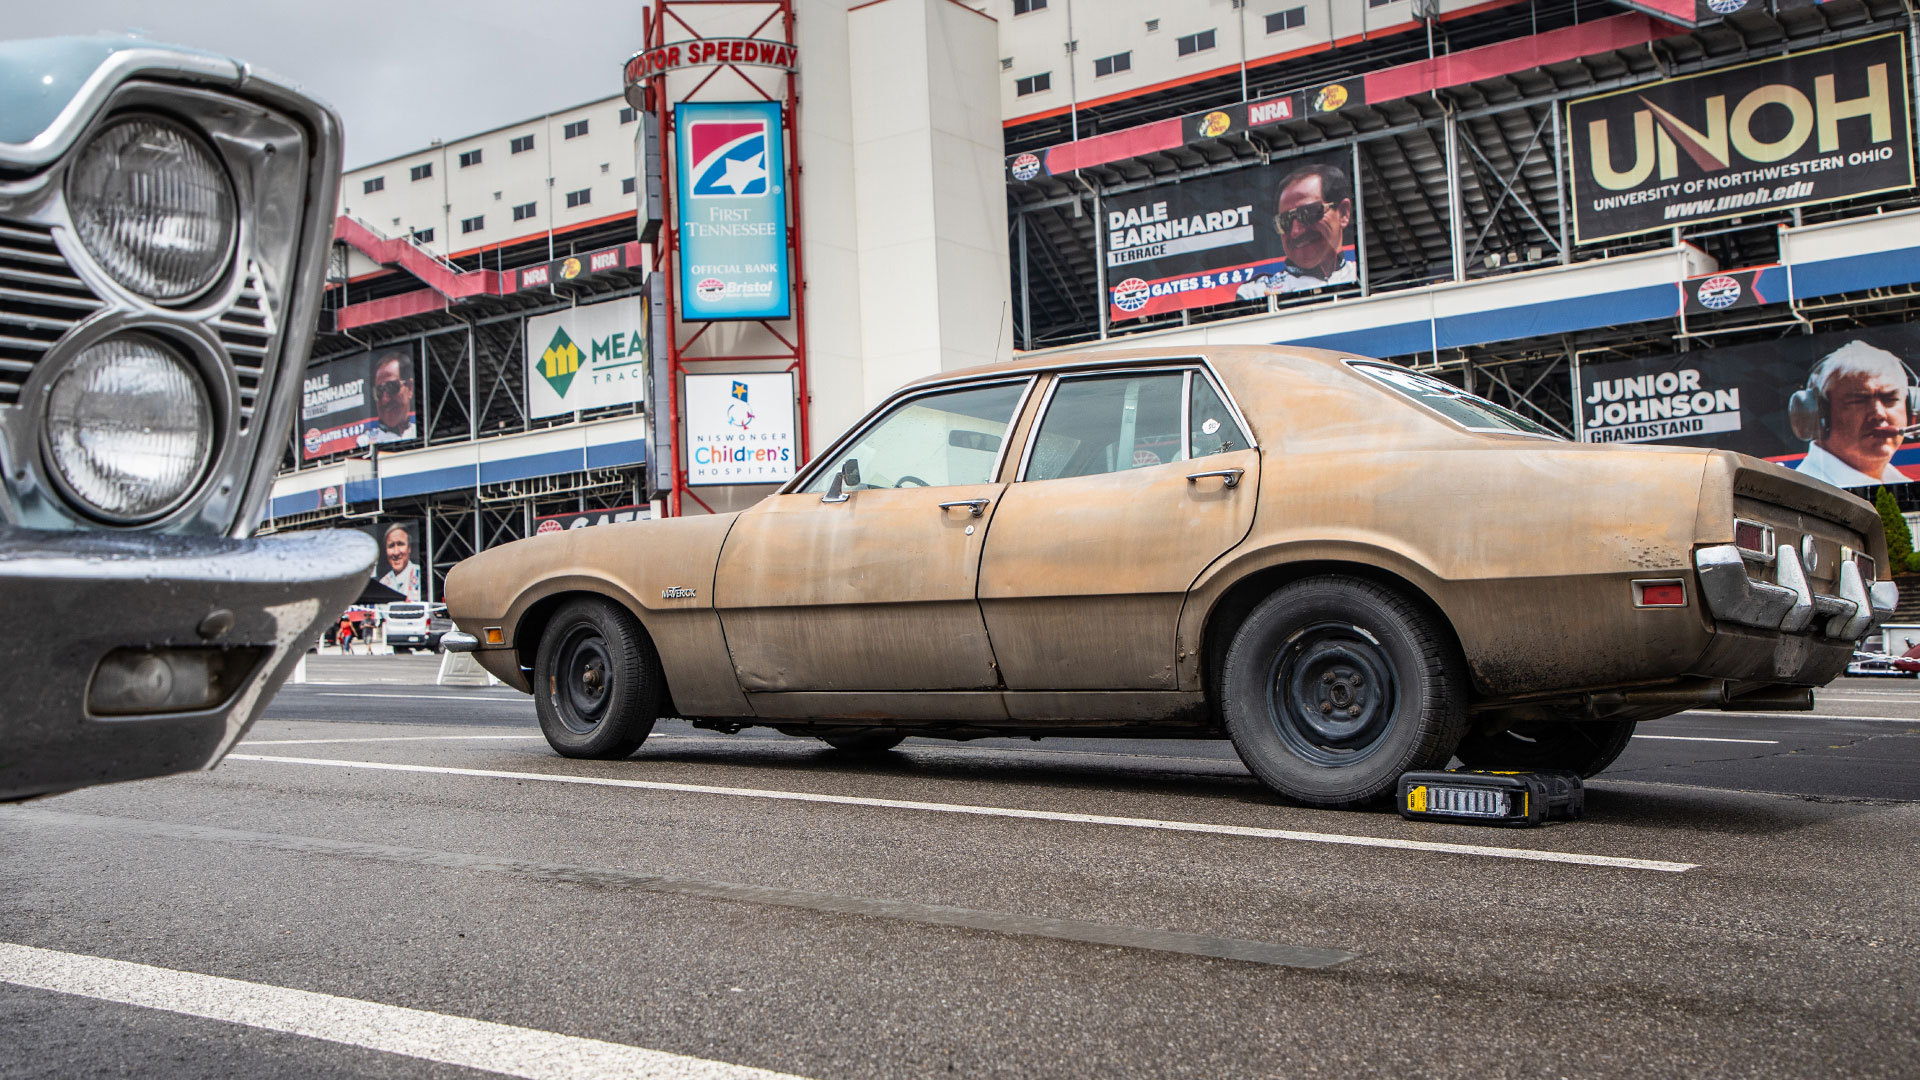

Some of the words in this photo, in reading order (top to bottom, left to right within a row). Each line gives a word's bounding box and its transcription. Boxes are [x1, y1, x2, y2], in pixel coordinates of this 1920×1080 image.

[628, 46, 680, 82] MOTOR
[688, 41, 798, 68] SPEEDWAY
[1251, 101, 1289, 123] NRA
[1589, 63, 1892, 190] UNOH
[1593, 183, 1681, 211] UNIVERSITY
[1684, 178, 1705, 194] OF
[1707, 155, 1844, 190] NORTHWESTERN
[1848, 146, 1893, 167] OHIO
[1664, 180, 1814, 220] www.unoh.edu
[709, 206, 752, 221] FIRST
[1109, 201, 1168, 231] DALE
[685, 222, 776, 237] TENNESSEE
[1110, 205, 1253, 251] EARNHARDT
[592, 252, 618, 270] NRA
[1113, 243, 1167, 263] TERRACE
[523, 268, 548, 286] NRA
[691, 264, 742, 275] OFFICIAL
[745, 263, 778, 273] BANK
[726, 281, 773, 293] Bristol
[1151, 277, 1198, 296] GATES
[1202, 275, 1215, 290] 5,
[1219, 272, 1229, 285] 6
[1231, 269, 1242, 283] &
[1244, 268, 1254, 281] 7
[304, 374, 329, 394] DALE
[304, 379, 364, 408] EARNHARDT
[1585, 369, 1701, 404] JUNIOR
[1587, 387, 1740, 428] JOHNSON
[697, 433, 787, 442] NISWONGER
[1591, 418, 1704, 443] GRANDSTAND
[695, 445, 789, 464] Children's
[698, 466, 788, 476] HOSPITAL
